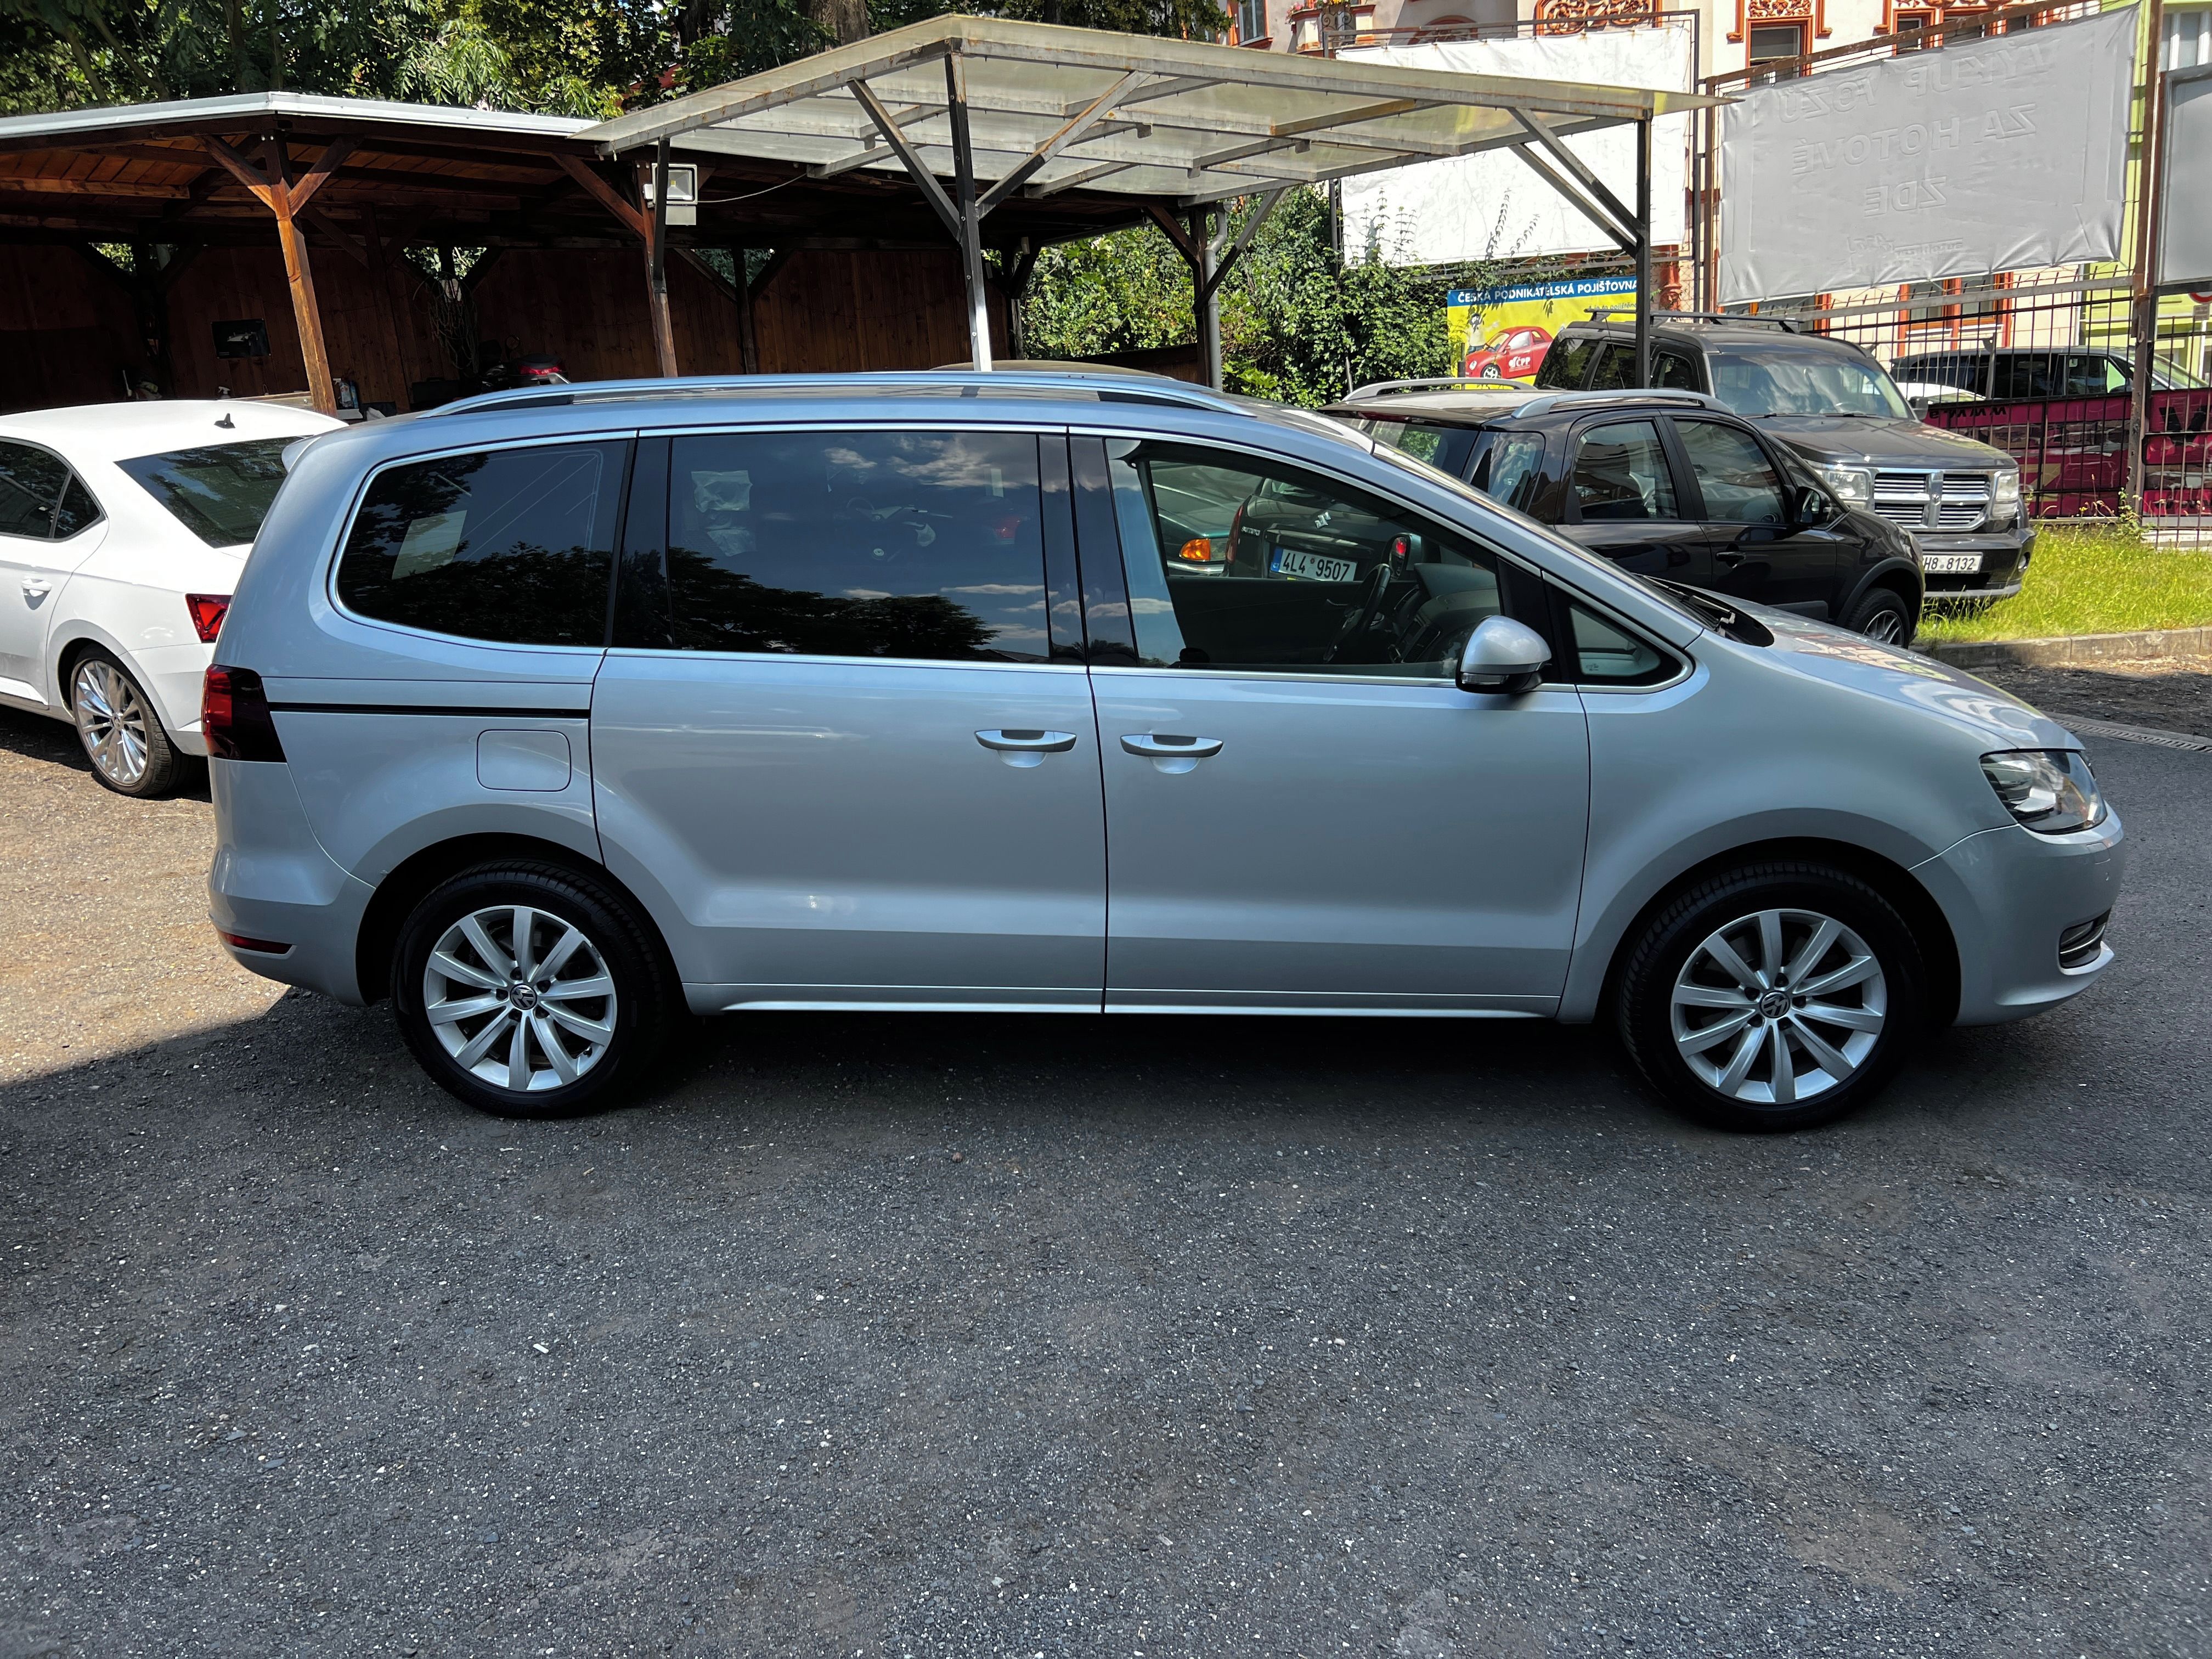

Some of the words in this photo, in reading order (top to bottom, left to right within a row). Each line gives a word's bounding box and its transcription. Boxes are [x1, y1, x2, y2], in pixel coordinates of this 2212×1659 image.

[1458, 291, 1491, 303] ČESKÁ
[1494, 283, 1575, 300] PODNIKATELSKÁ
[1578, 280, 1637, 294] POJIŠŤOVNA
[1516, 356, 1531, 366] ČPP
[1283, 552, 1306, 574] 4L4
[1316, 559, 1350, 582] 9507
[1922, 557, 1939, 570] H8
[1947, 557, 1975, 570] 8132
